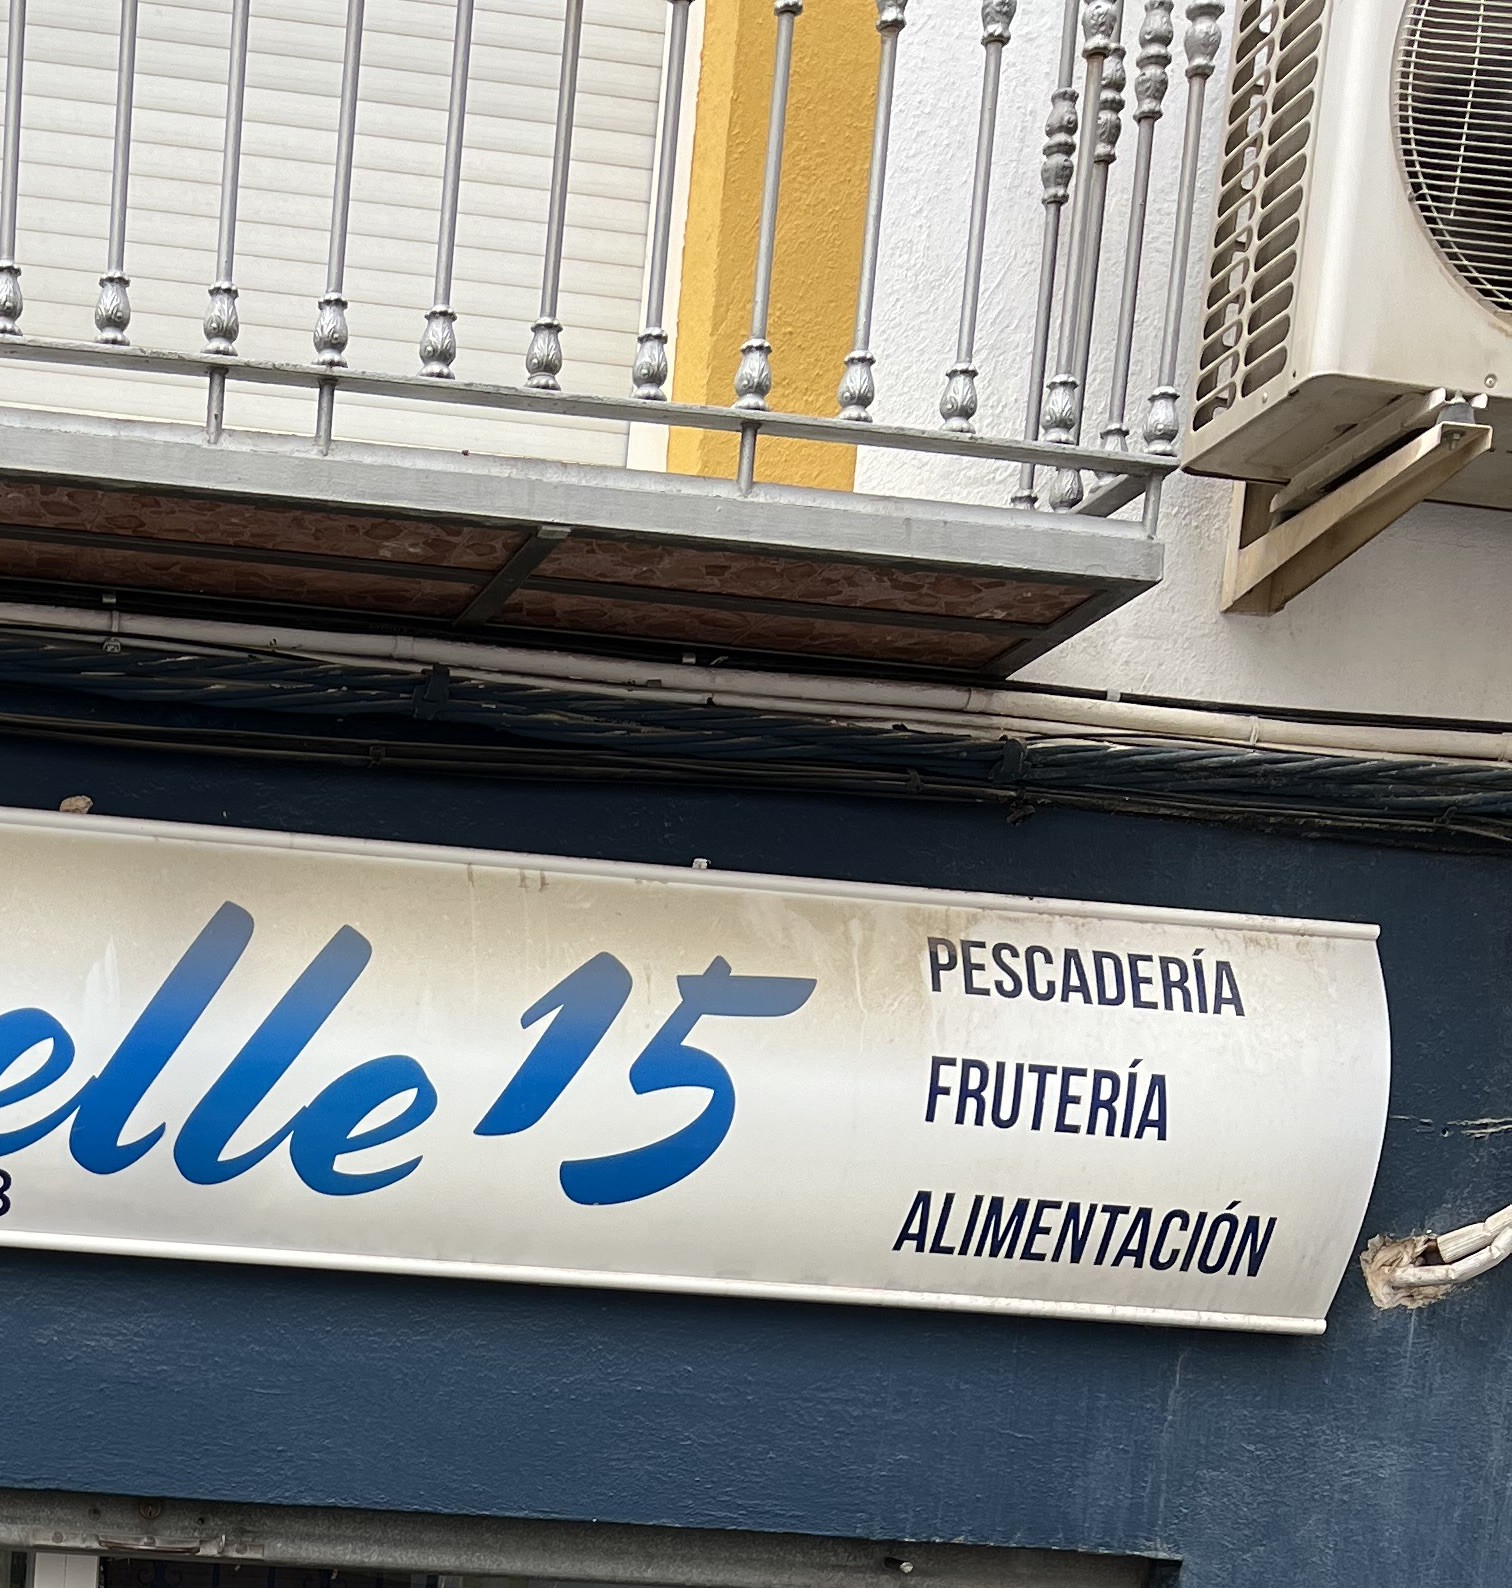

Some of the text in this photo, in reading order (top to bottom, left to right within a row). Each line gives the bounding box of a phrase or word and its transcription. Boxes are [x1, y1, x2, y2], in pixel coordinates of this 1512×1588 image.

[927, 936, 1245, 1017] PESCADERÍA
[474, 951, 817, 1206] 15
[925, 1055, 1167, 1141] FRUTERÍA
[892, 1190, 1278, 1278] ALIMENTACIÓN
